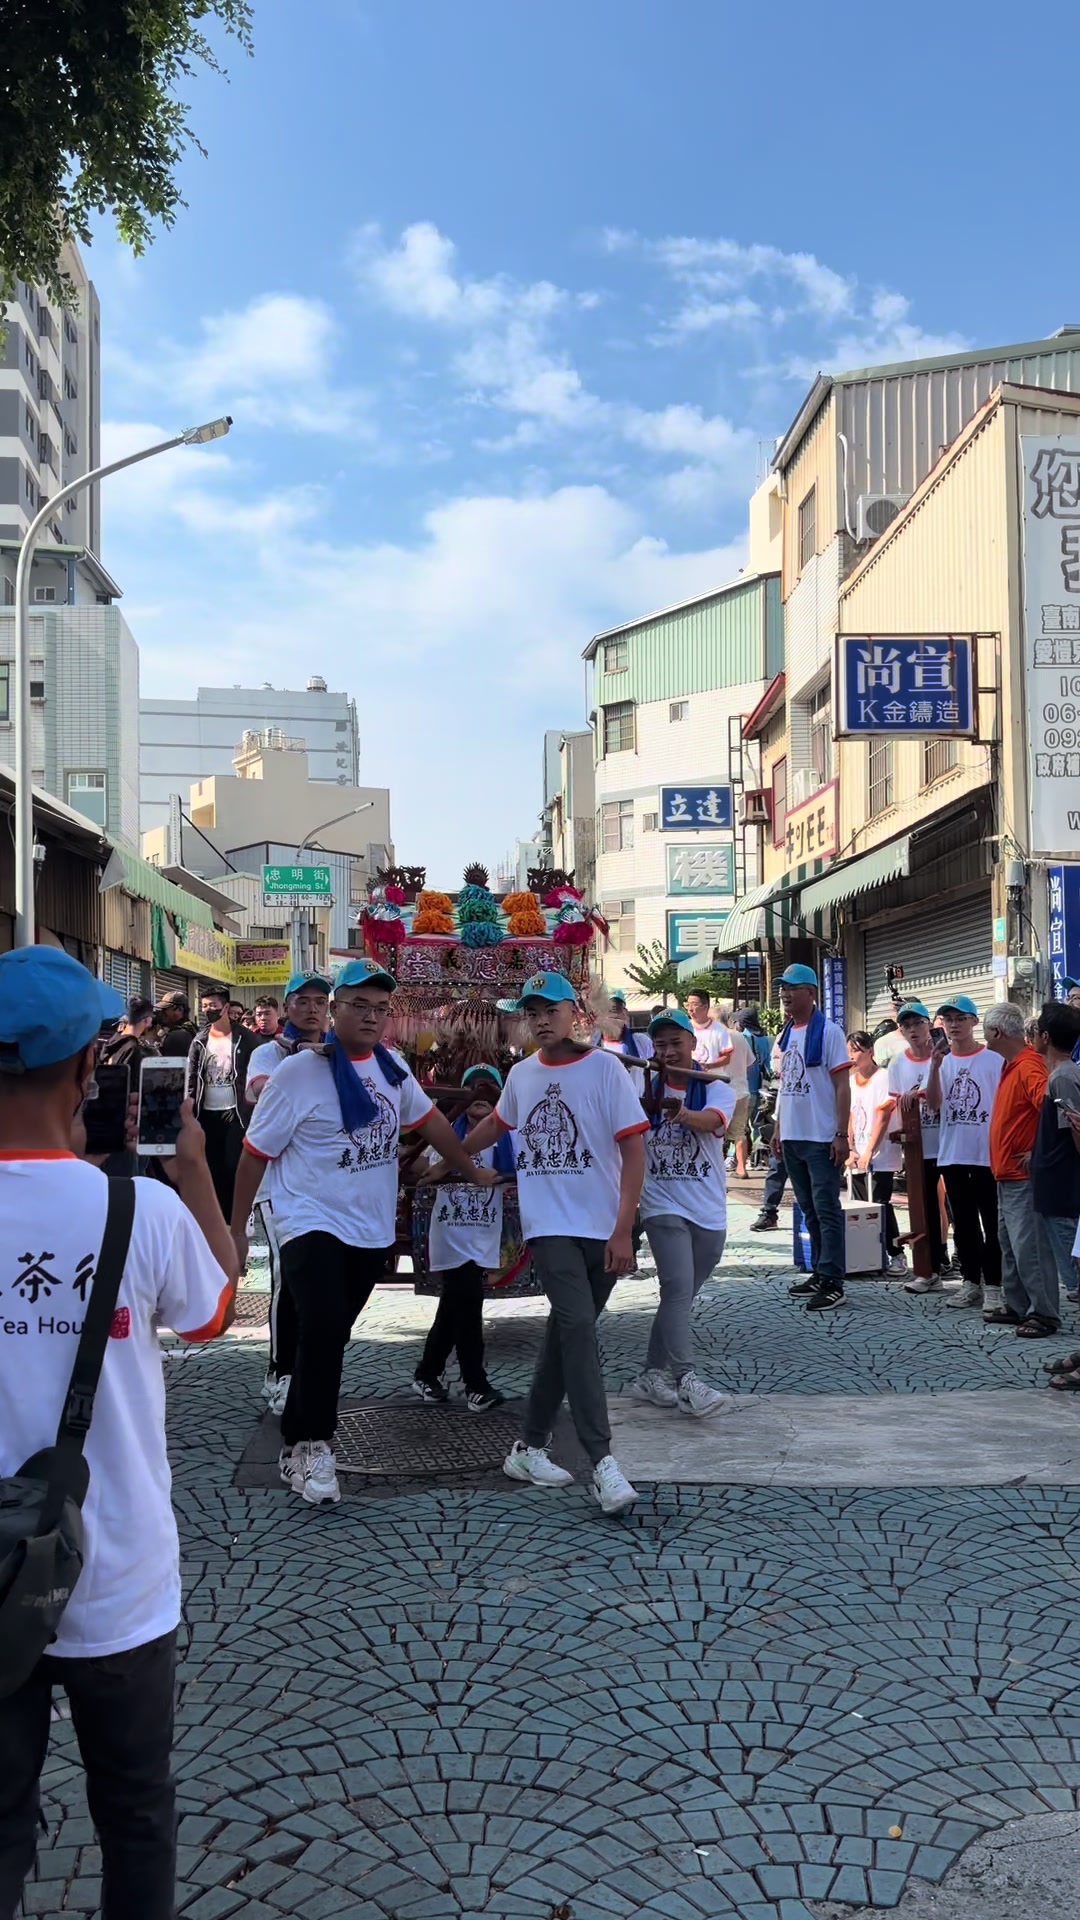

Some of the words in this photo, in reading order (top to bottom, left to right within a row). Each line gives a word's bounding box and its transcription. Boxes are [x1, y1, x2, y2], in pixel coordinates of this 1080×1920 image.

[857, 645, 957, 694] 尚宣
[858, 699, 960, 723] K金鑄造
[1043, 728, 1080, 749] 09
[665, 790, 727, 824] 立達
[270, 869, 325, 880] 忠明街
[672, 851, 729, 889] 機
[270, 882, 312, 891] Jhongming
[516, 1149, 593, 1171] 嘉義忠應堂
